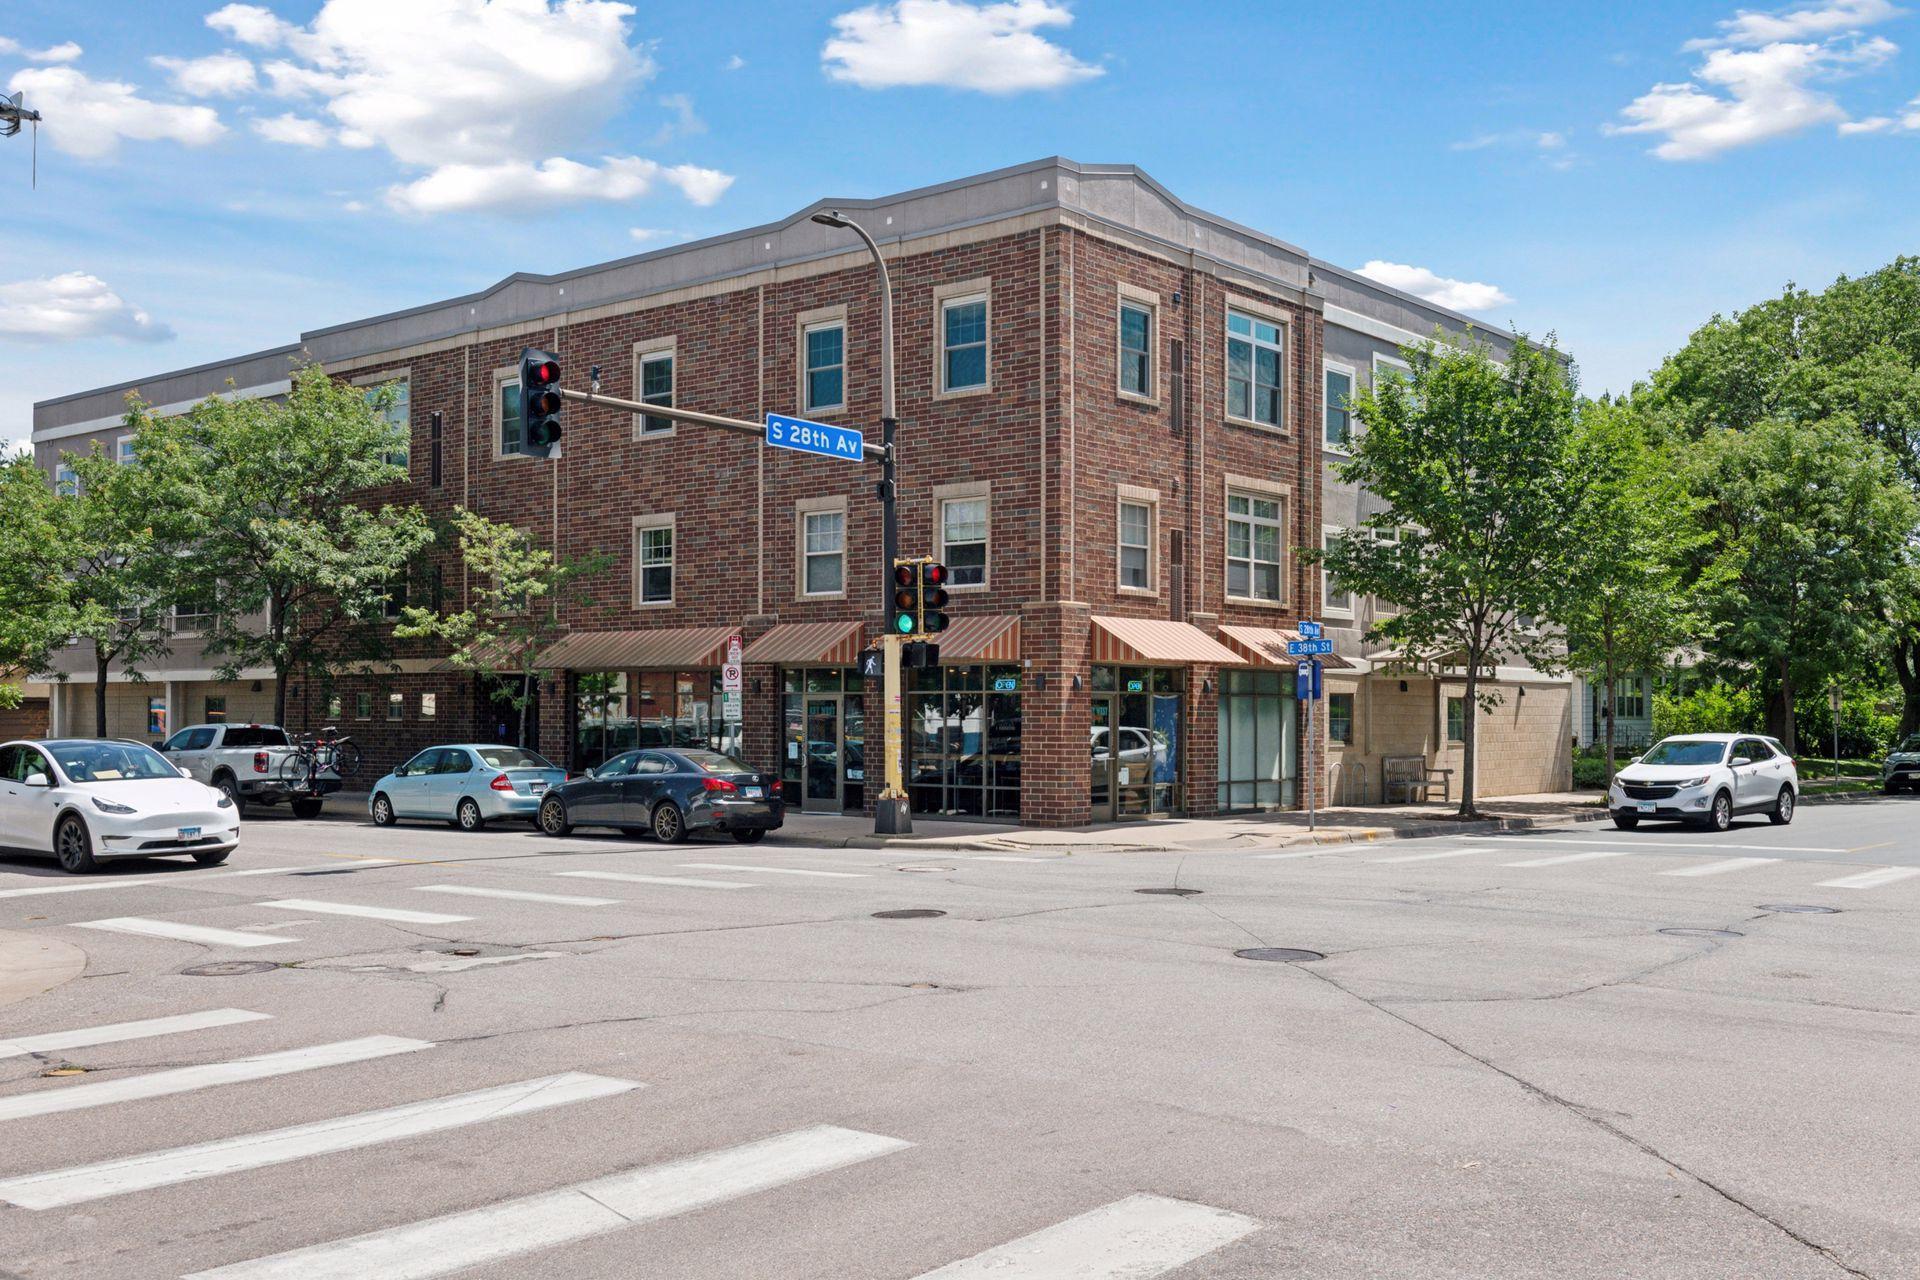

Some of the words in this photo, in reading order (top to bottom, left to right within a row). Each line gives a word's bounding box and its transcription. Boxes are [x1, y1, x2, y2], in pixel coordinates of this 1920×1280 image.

[772, 421, 783, 440] S
[790, 425, 830, 448] 28th
[836, 435, 858, 454] Av
[1290, 643, 1295, 653] E
[1297, 643, 1318, 653] 38th
[1321, 642, 1331, 652] St
